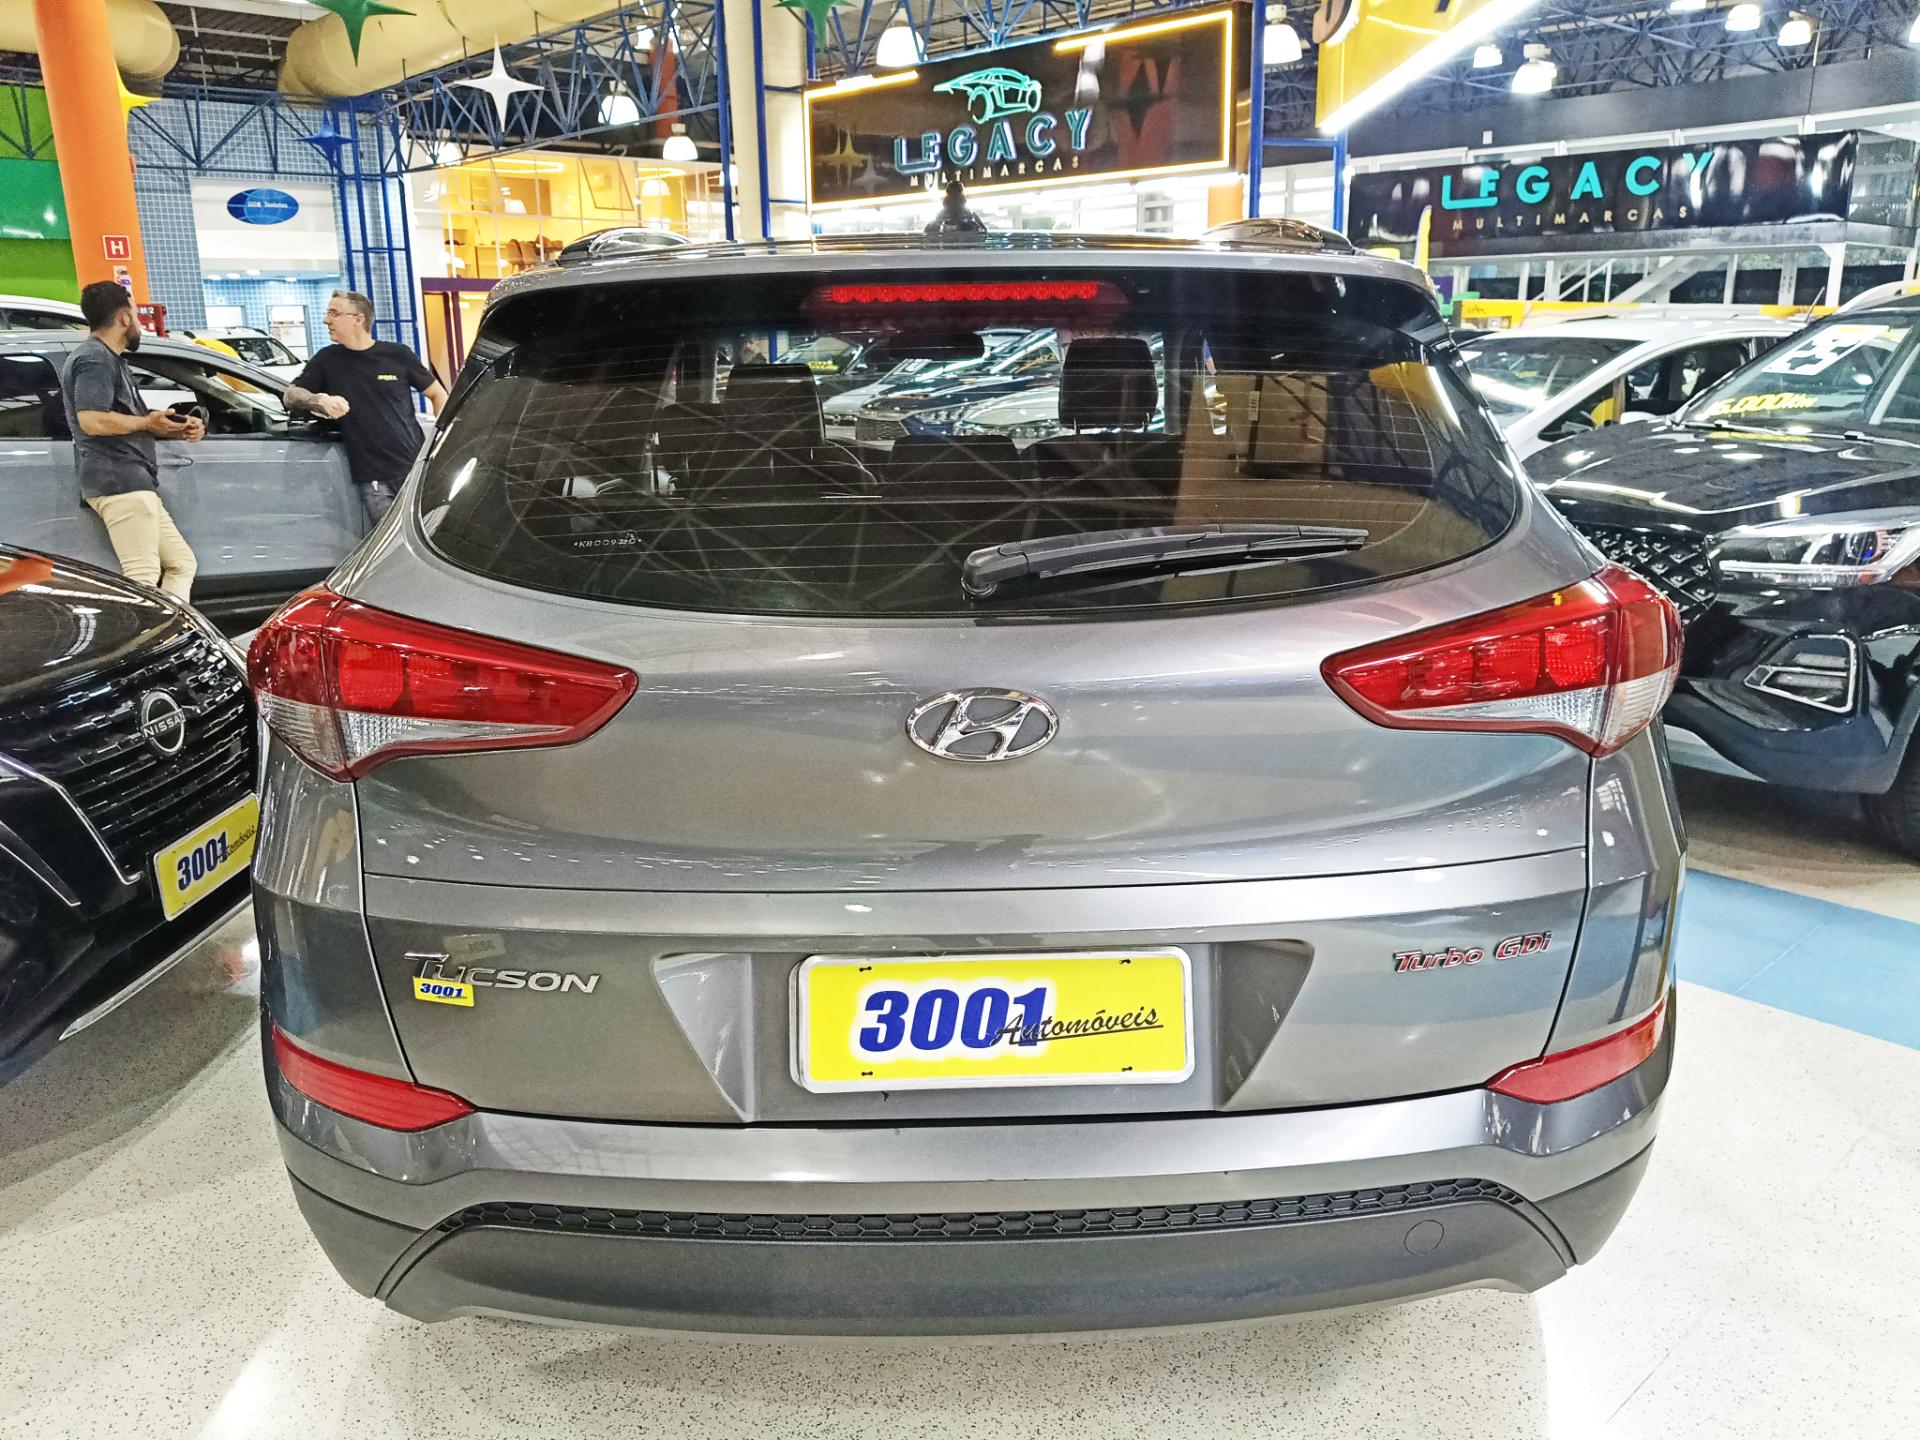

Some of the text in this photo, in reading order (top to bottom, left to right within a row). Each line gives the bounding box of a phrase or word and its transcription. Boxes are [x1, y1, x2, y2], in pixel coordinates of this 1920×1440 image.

[894, 108, 1091, 173] LEGACY
[910, 155, 1079, 187] MULTIMARCAS
[1441, 151, 1713, 210] LEGACY
[1453, 206, 1687, 231] MULTIMARCAS
[110, 240, 125, 255] H
[143, 710, 186, 738] NISSAN
[177, 831, 228, 891] 3001
[1395, 947, 1484, 973] Turbo
[420, 983, 463, 998] 3001
[859, 986, 1162, 1053] 3001 Automóveis
